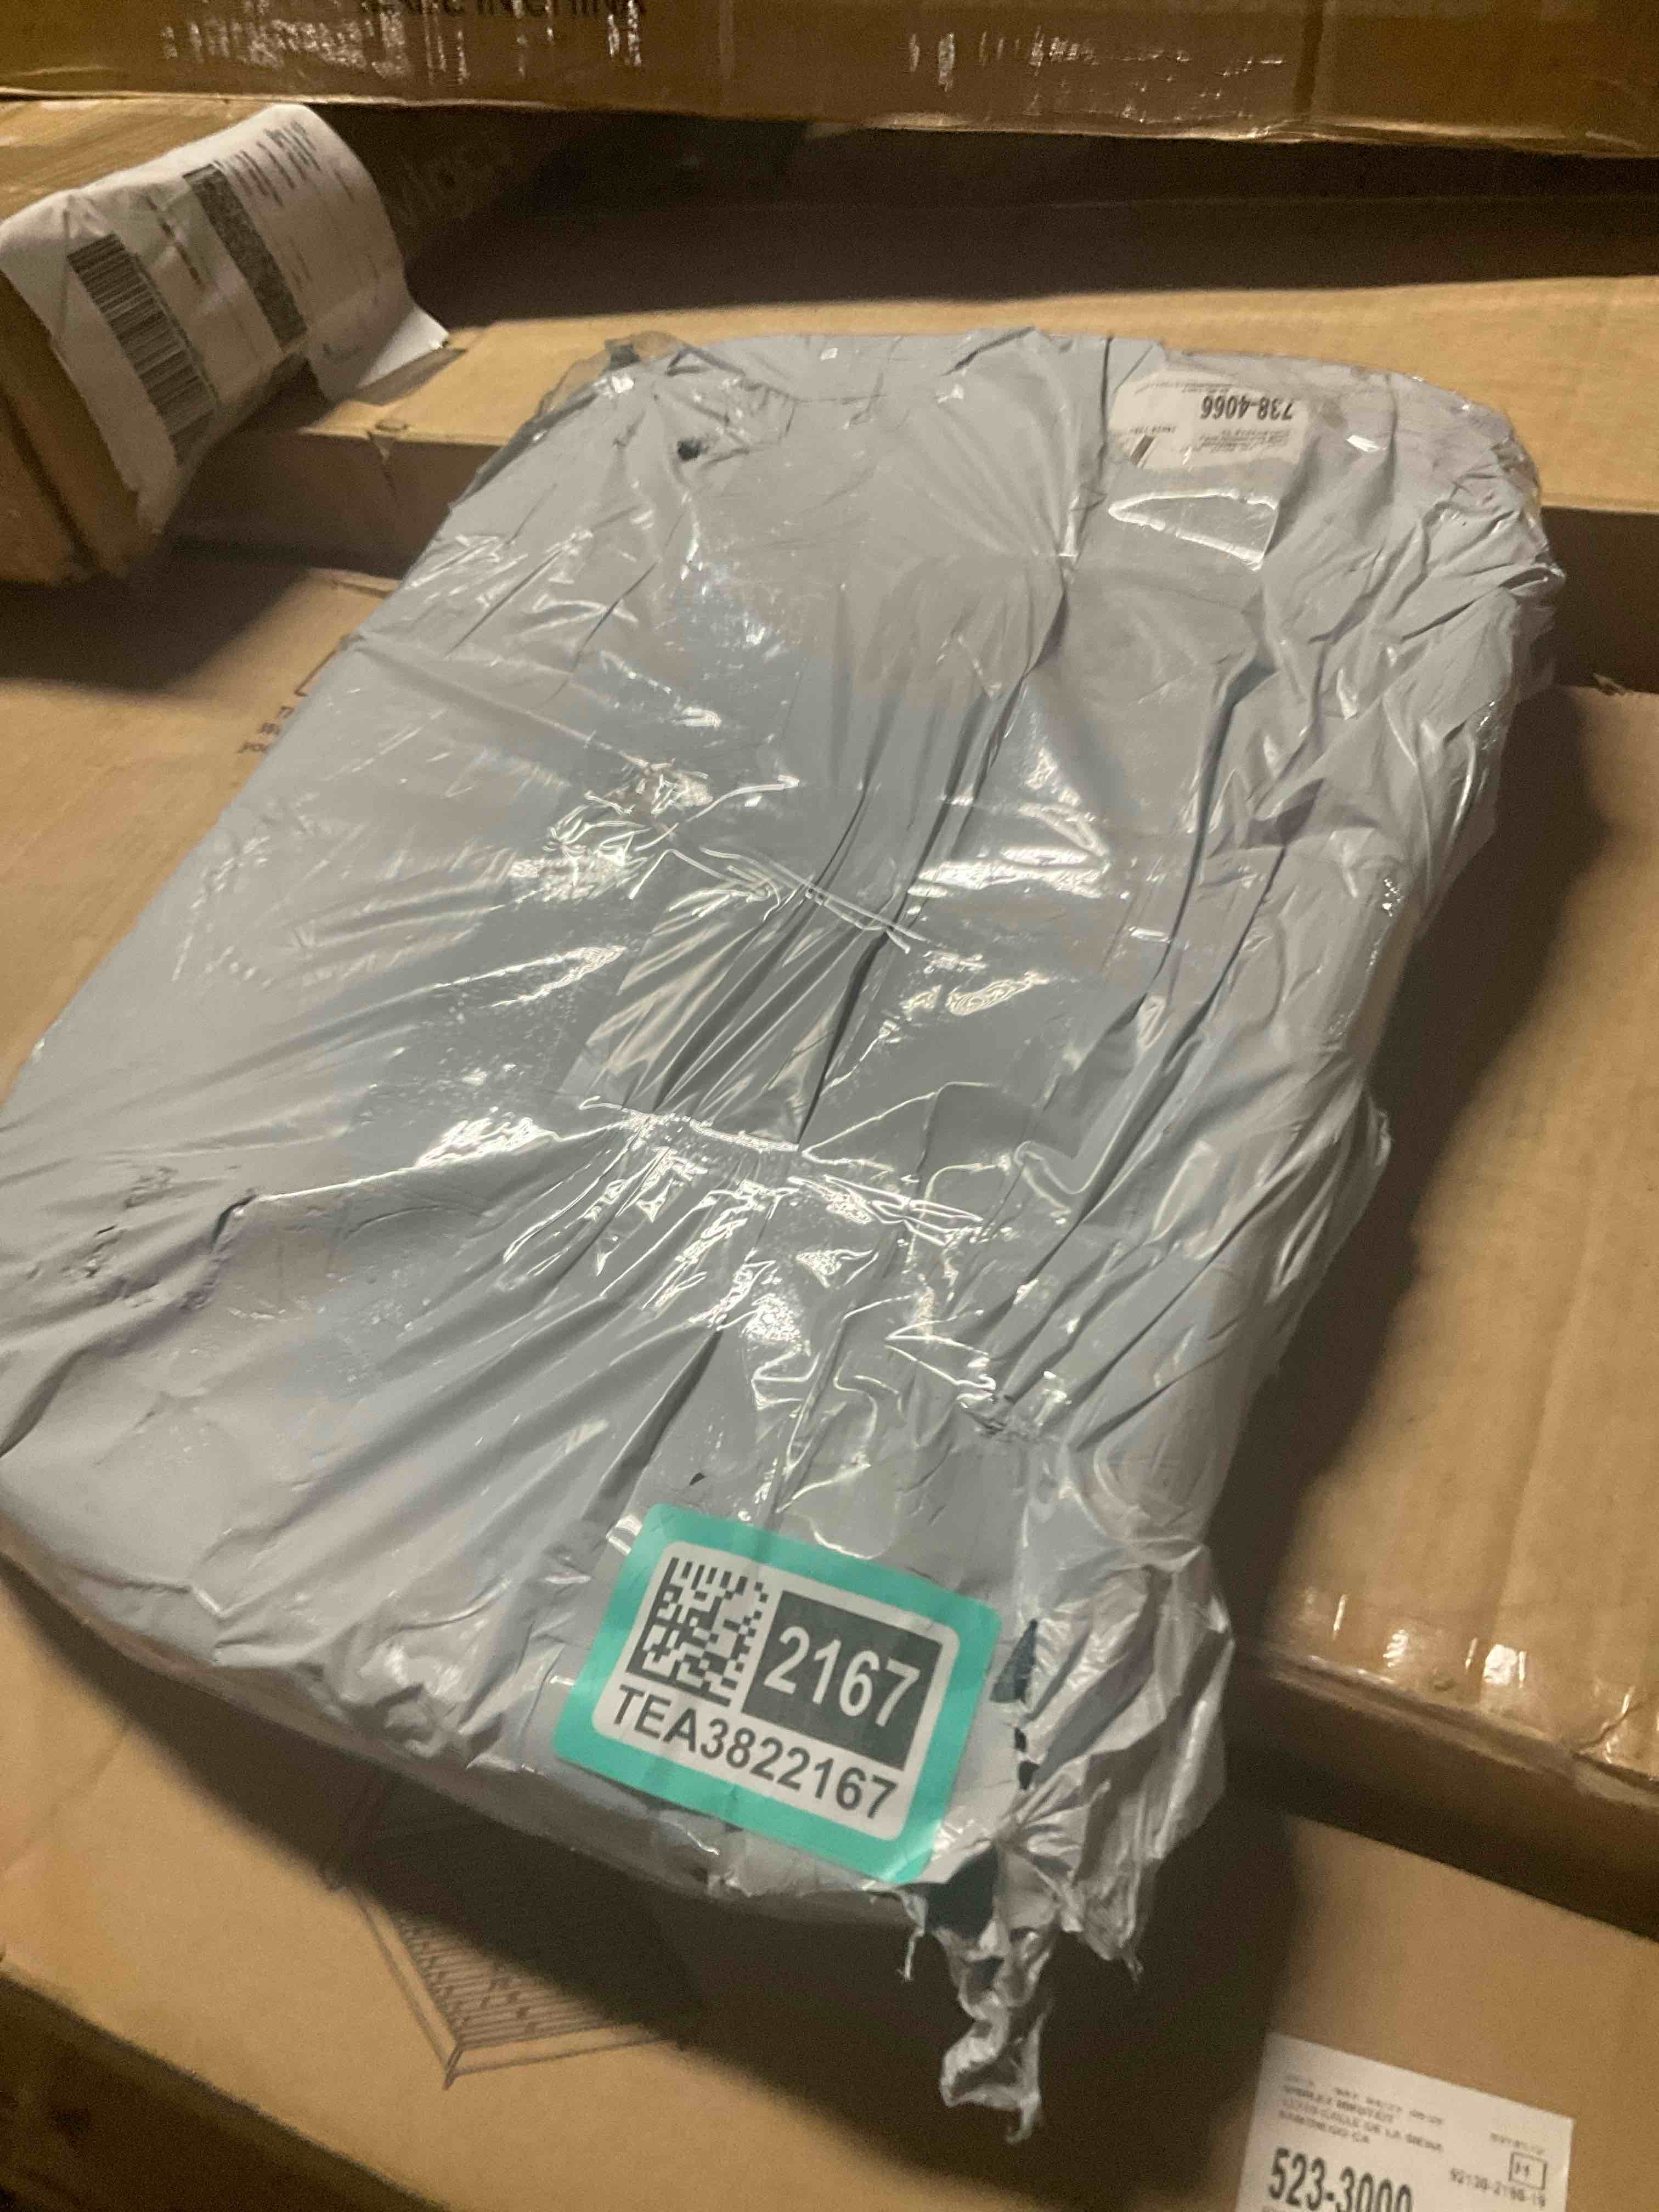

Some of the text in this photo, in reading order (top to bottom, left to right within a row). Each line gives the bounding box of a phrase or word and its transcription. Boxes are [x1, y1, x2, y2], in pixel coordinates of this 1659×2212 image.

[1200, 395, 1294, 421] 738-4066
[764, 1627, 921, 1727] 2167
[614, 1685, 898, 1819] TEA3822167
